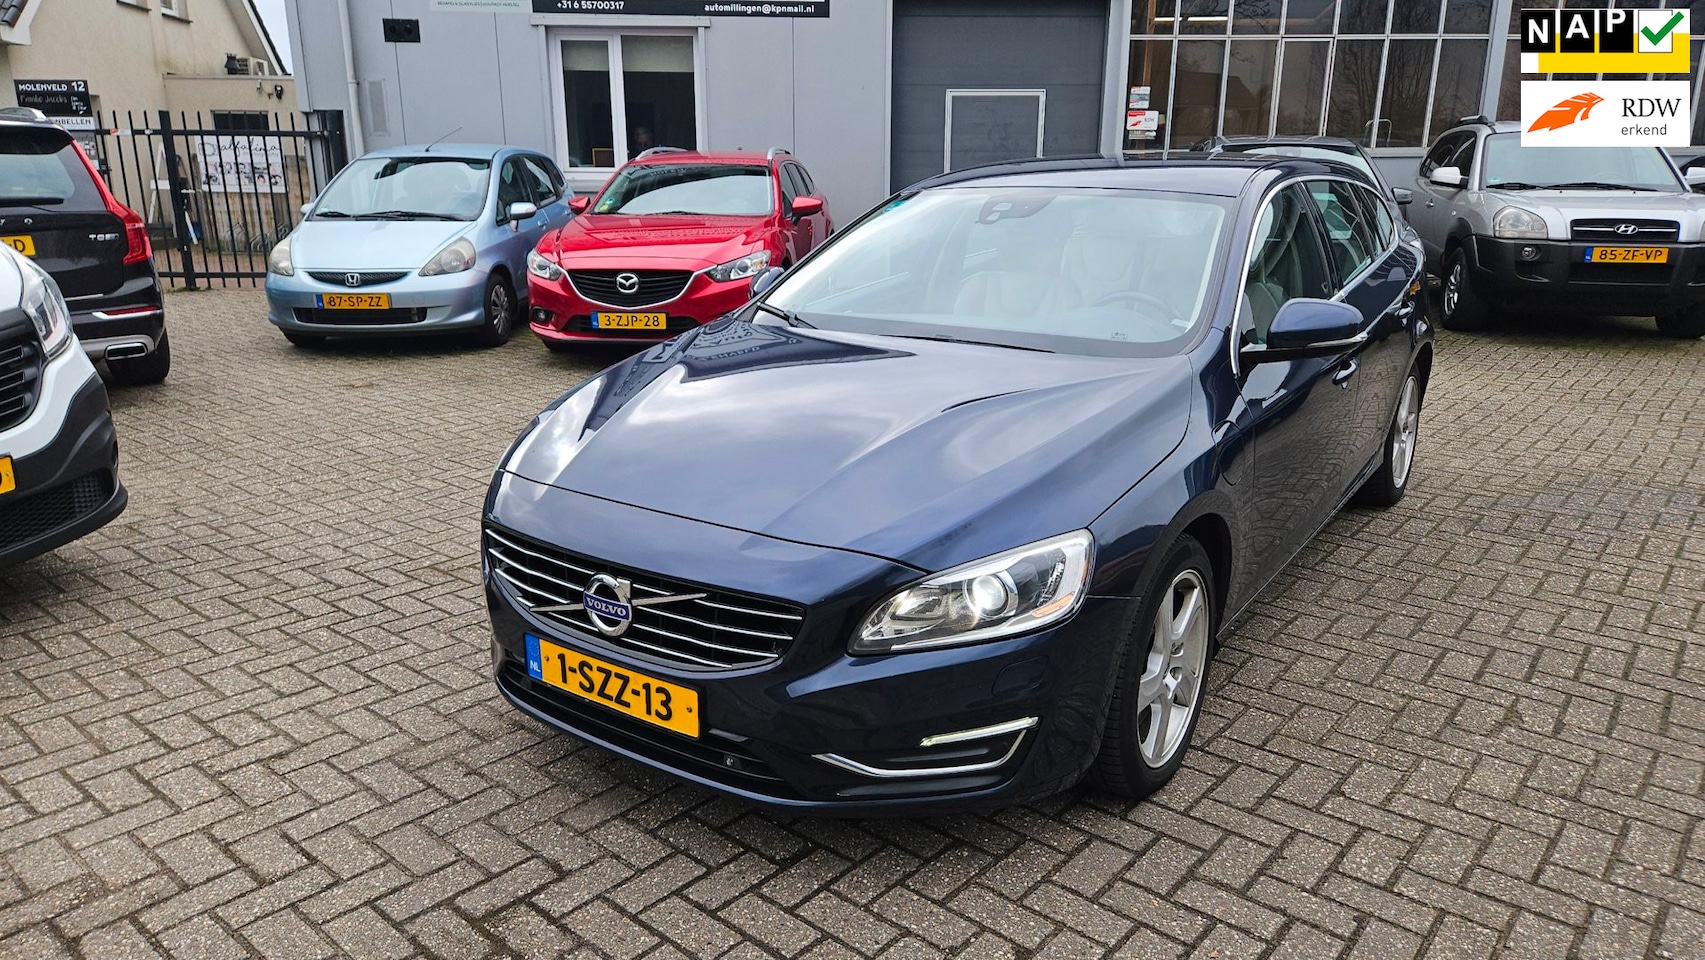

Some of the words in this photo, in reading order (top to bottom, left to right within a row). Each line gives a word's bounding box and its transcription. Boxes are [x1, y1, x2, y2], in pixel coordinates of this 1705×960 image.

[557, 1, 572, 9] +31
[573, 1, 580, 9] 6
[581, 1, 625, 10] 55700317
[704, 4, 815, 14] automillingen@kpnmail.nl
[71, 81, 86, 92] 12
[1599, 249, 1663, 261] 85-ZF-VP
[328, 296, 383, 307] 87-SP-ZZ
[604, 315, 660, 327] 3-ZJP-28
[586, 597, 627, 617] VOLVO
[529, 659, 541, 673] NL
[557, 653, 673, 722] 1-SZZ-13
